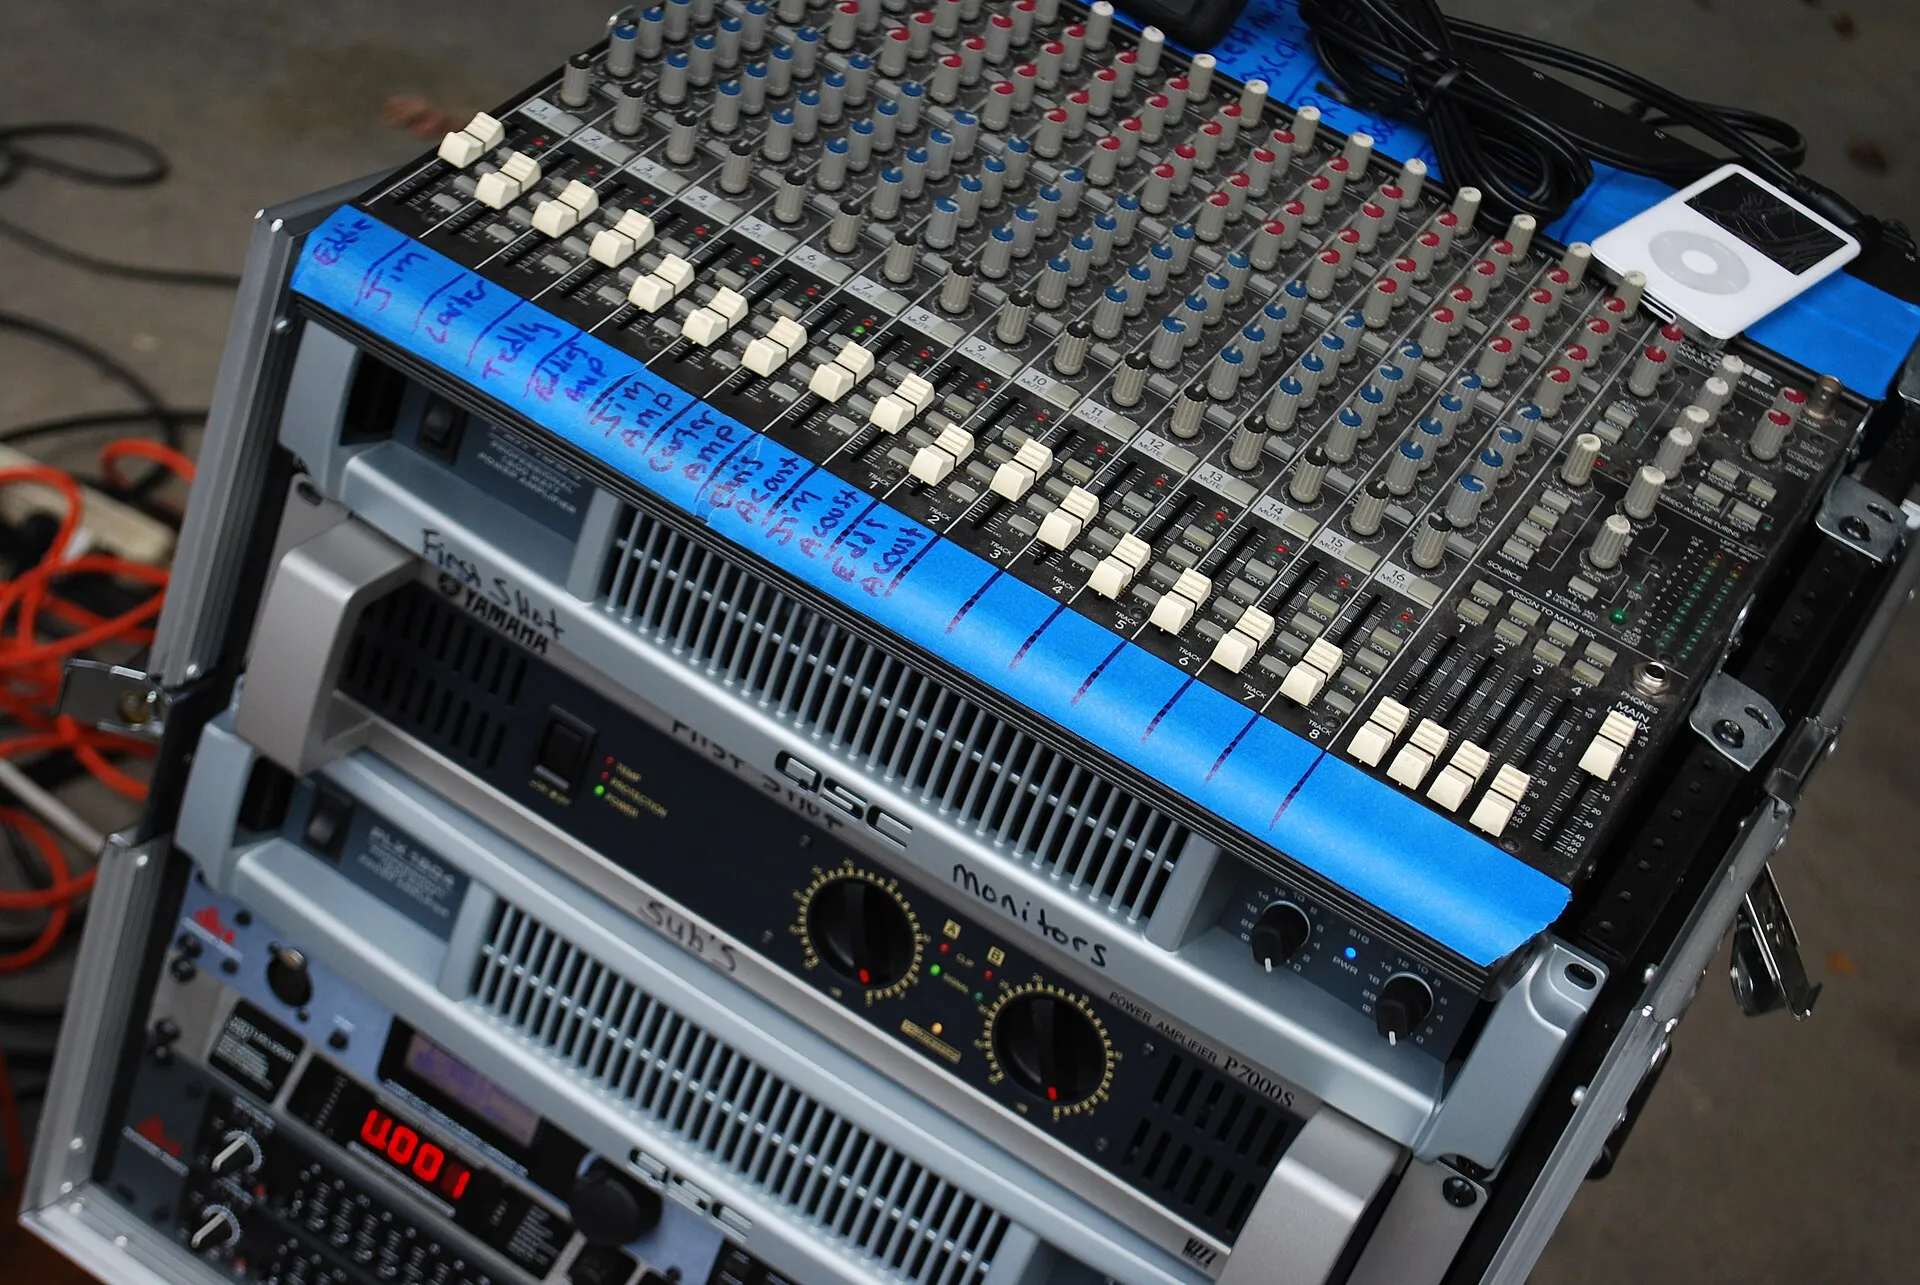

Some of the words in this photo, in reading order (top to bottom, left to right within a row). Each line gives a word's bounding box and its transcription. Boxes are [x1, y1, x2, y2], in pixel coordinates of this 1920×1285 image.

[364, 252, 429, 313] Jim
[482, 322, 563, 380] Teddy
[965, 347, 990, 364] MUTE
[1022, 377, 1045, 394] MUTE
[589, 381, 658, 438] Jim
[943, 407, 962, 419] SOLO
[1079, 409, 1104, 426] MUTE
[648, 410, 718, 473] Carter
[1138, 441, 1162, 457] MUTE
[868, 472, 891, 488] TRACK
[871, 481, 878, 489] 1
[1061, 472, 1081, 485] SOLO
[1199, 473, 1222, 490] MUTE
[765, 489, 822, 547] Jim
[928, 506, 951, 522] TRACK
[1121, 505, 1142, 518] SOLO
[1258, 507, 1282, 523] MUTE
[927, 514, 940, 524] 2
[1684, 506, 1702, 519] AUX
[1702, 514, 1740, 538] RETURNS
[990, 540, 1013, 557] TRACK
[1183, 538, 1202, 551] SOLO
[1319, 539, 1344, 556] MUTE
[421, 528, 482, 588] First
[989, 549, 1001, 559] 3
[1496, 550, 1516, 565] MAIN
[1516, 561, 1530, 571] MIX
[1486, 560, 1523, 583] SOURCE
[1582, 570, 1601, 583] SOLO
[1052, 575, 1075, 591] TRACK
[1245, 573, 1264, 586] SOLO
[1380, 572, 1405, 590] MUTE
[1051, 583, 1062, 594] 4
[1567, 588, 1588, 602] MODE
[1473, 596, 1490, 608] LEFT
[1115, 611, 1139, 627] TRACK
[1307, 608, 1327, 620] SOLO
[1456, 613, 1479, 627] RIGHT
[1506, 589, 1539, 609] ASSIGN
[1540, 606, 1554, 616] TO
[1554, 613, 1579, 630] MAIN
[1579, 627, 1597, 639] MIX
[465, 588, 550, 655] YAMAHA
[1115, 619, 1127, 630] 5
[1510, 616, 1528, 628] LEFT
[1458, 624, 1467, 633] 1
[1494, 633, 1516, 647] RIGHT
[1549, 636, 1566, 648] LEFT
[1178, 646, 1202, 662] TRACK
[1370, 643, 1391, 656] SOLO
[1493, 643, 1506, 655] 2
[1178, 655, 1189, 666] 6
[1533, 654, 1554, 668] RIGHT
[1586, 656, 1604, 669] LEFT
[1533, 664, 1544, 675] 3
[1243, 682, 1267, 699] TRACK
[1243, 691, 1255, 701] 7
[1571, 686, 1583, 696] 4
[1621, 690, 1659, 714] PHONES
[1616, 701, 1650, 723] MAIN
[1308, 719, 1332, 736] TRACK
[1308, 728, 1320, 739] 8
[1537, 778, 1548, 787] 20
[610, 777, 668, 818] PROTECTION
[775, 750, 914, 850] QSC
[1529, 791, 1540, 800] 30
[1601, 793, 1611, 802] 10
[604, 792, 639, 819] POWER
[1591, 807, 1602, 816] 20
[1512, 815, 1523, 824] 60
[1516, 810, 1527, 819] 50
[1583, 820, 1594, 829] 30
[1571, 839, 1581, 848] 50
[1567, 846, 1578, 855] 60
[1257, 890, 1269, 901] 14
[1274, 886, 1286, 897] 12
[1293, 891, 1305, 902] 10
[1246, 903, 1258, 915] 18
[1332, 955, 1358, 975] PWR
[1380, 961, 1392, 972] 14
[1397, 958, 1409, 969] 12
[1416, 963, 1428, 974] 10
[1368, 974, 1380, 985] 18
[1109, 991, 1153, 1023] POWER
[1155, 1020, 1219, 1063] AMPLIFIER
[1223, 1055, 1295, 1108] P7000S
[628, 1147, 752, 1243] QSC
